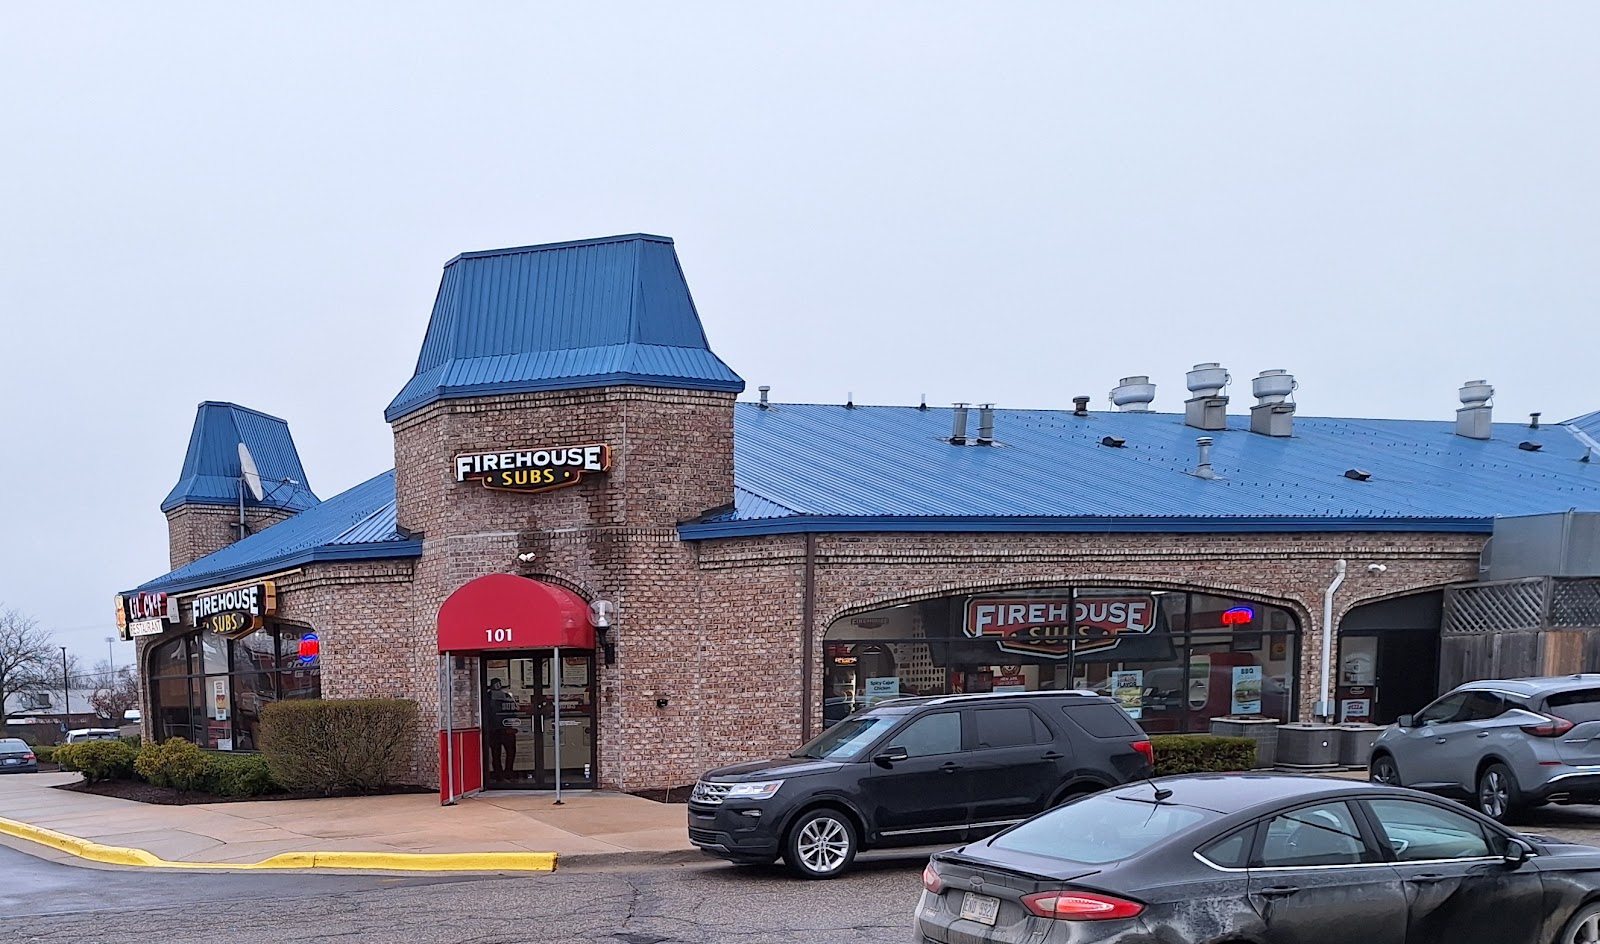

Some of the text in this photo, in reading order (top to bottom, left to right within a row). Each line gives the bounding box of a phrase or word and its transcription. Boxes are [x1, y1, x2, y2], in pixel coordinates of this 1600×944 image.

[456, 446, 602, 482] FIREHOUSE
[501, 468, 555, 486] SUBS
[192, 585, 259, 628] FIREHOUSE
[130, 619, 161, 635] RESTAURANT
[212, 613, 238, 633] SUBS
[975, 602, 1147, 638] FIREHOUSE
[485, 628, 513, 643] 101
